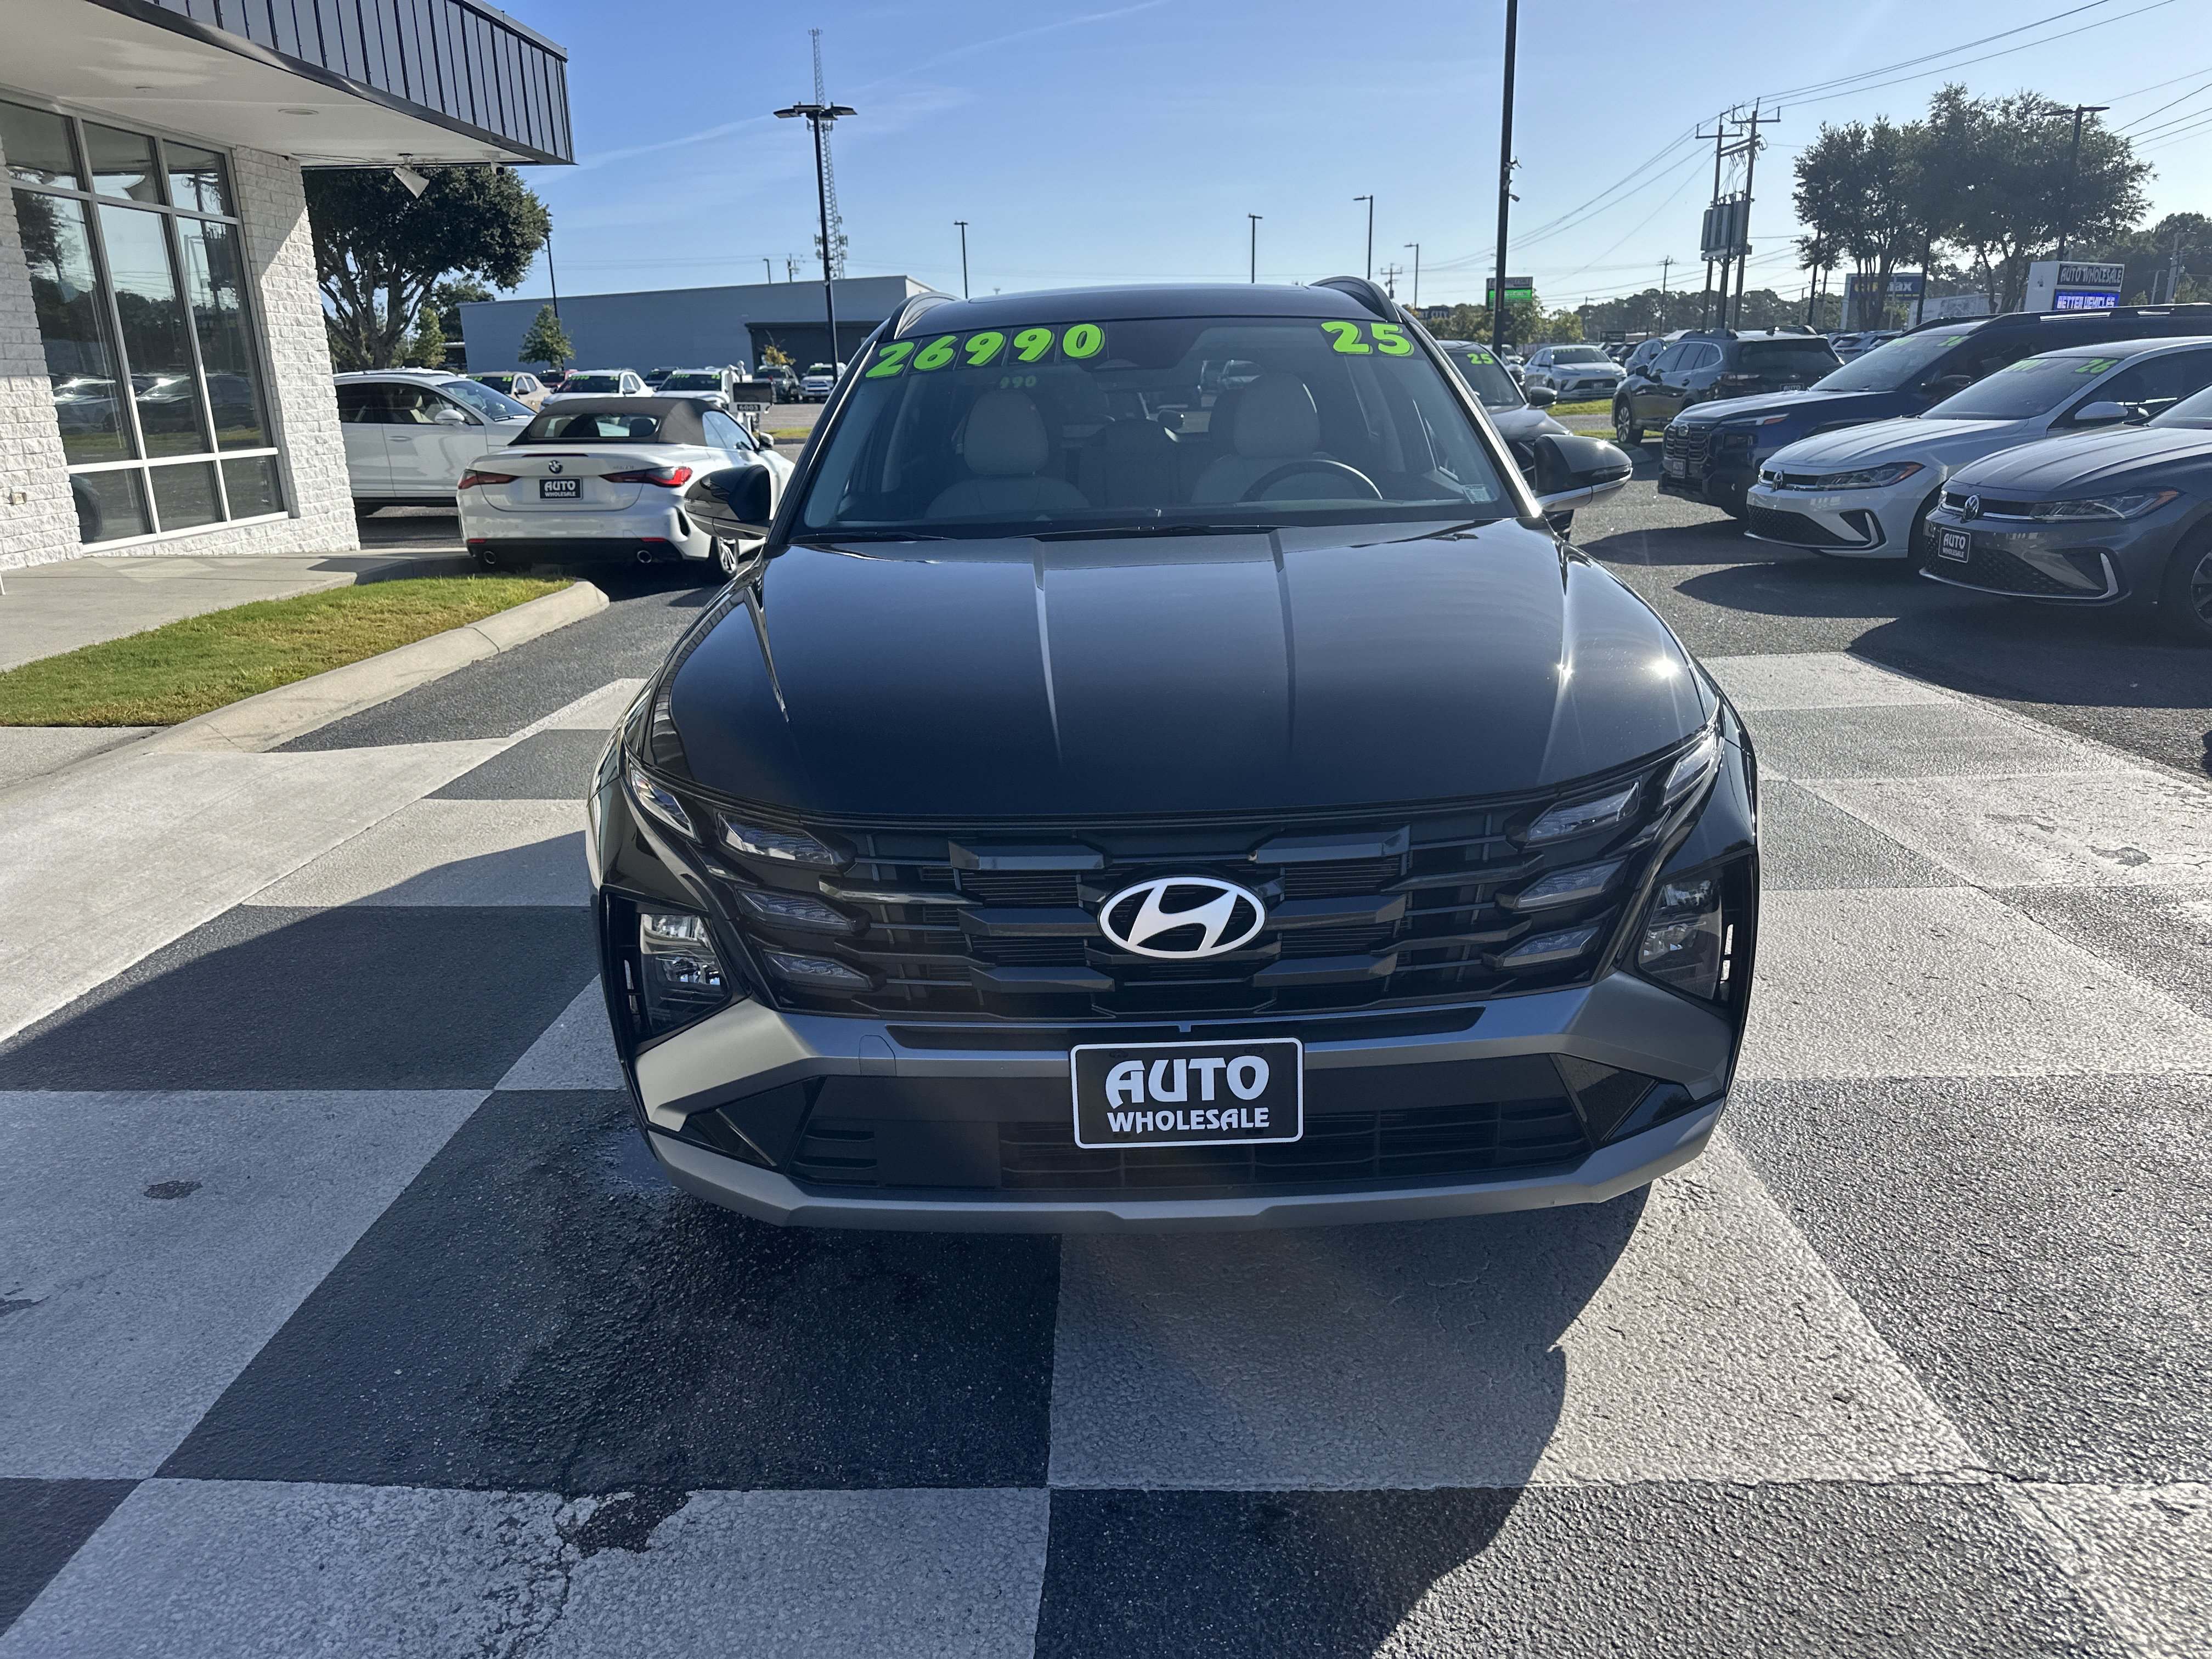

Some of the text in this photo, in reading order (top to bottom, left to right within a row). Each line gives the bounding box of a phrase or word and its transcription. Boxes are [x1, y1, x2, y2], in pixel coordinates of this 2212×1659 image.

[2061, 266, 2122, 284] AUTO WHOLESALE
[1321, 321, 1414, 357] 25
[865, 323, 1105, 379] 26990
[1466, 353, 1494, 365] 25
[2074, 359, 2118, 374] 26
[544, 480, 576, 492] AUTO
[1943, 533, 1966, 549] AUTO
[1105, 1055, 1270, 1109] AUTO
[1107, 1107, 1270, 1134] WHOLESALE
